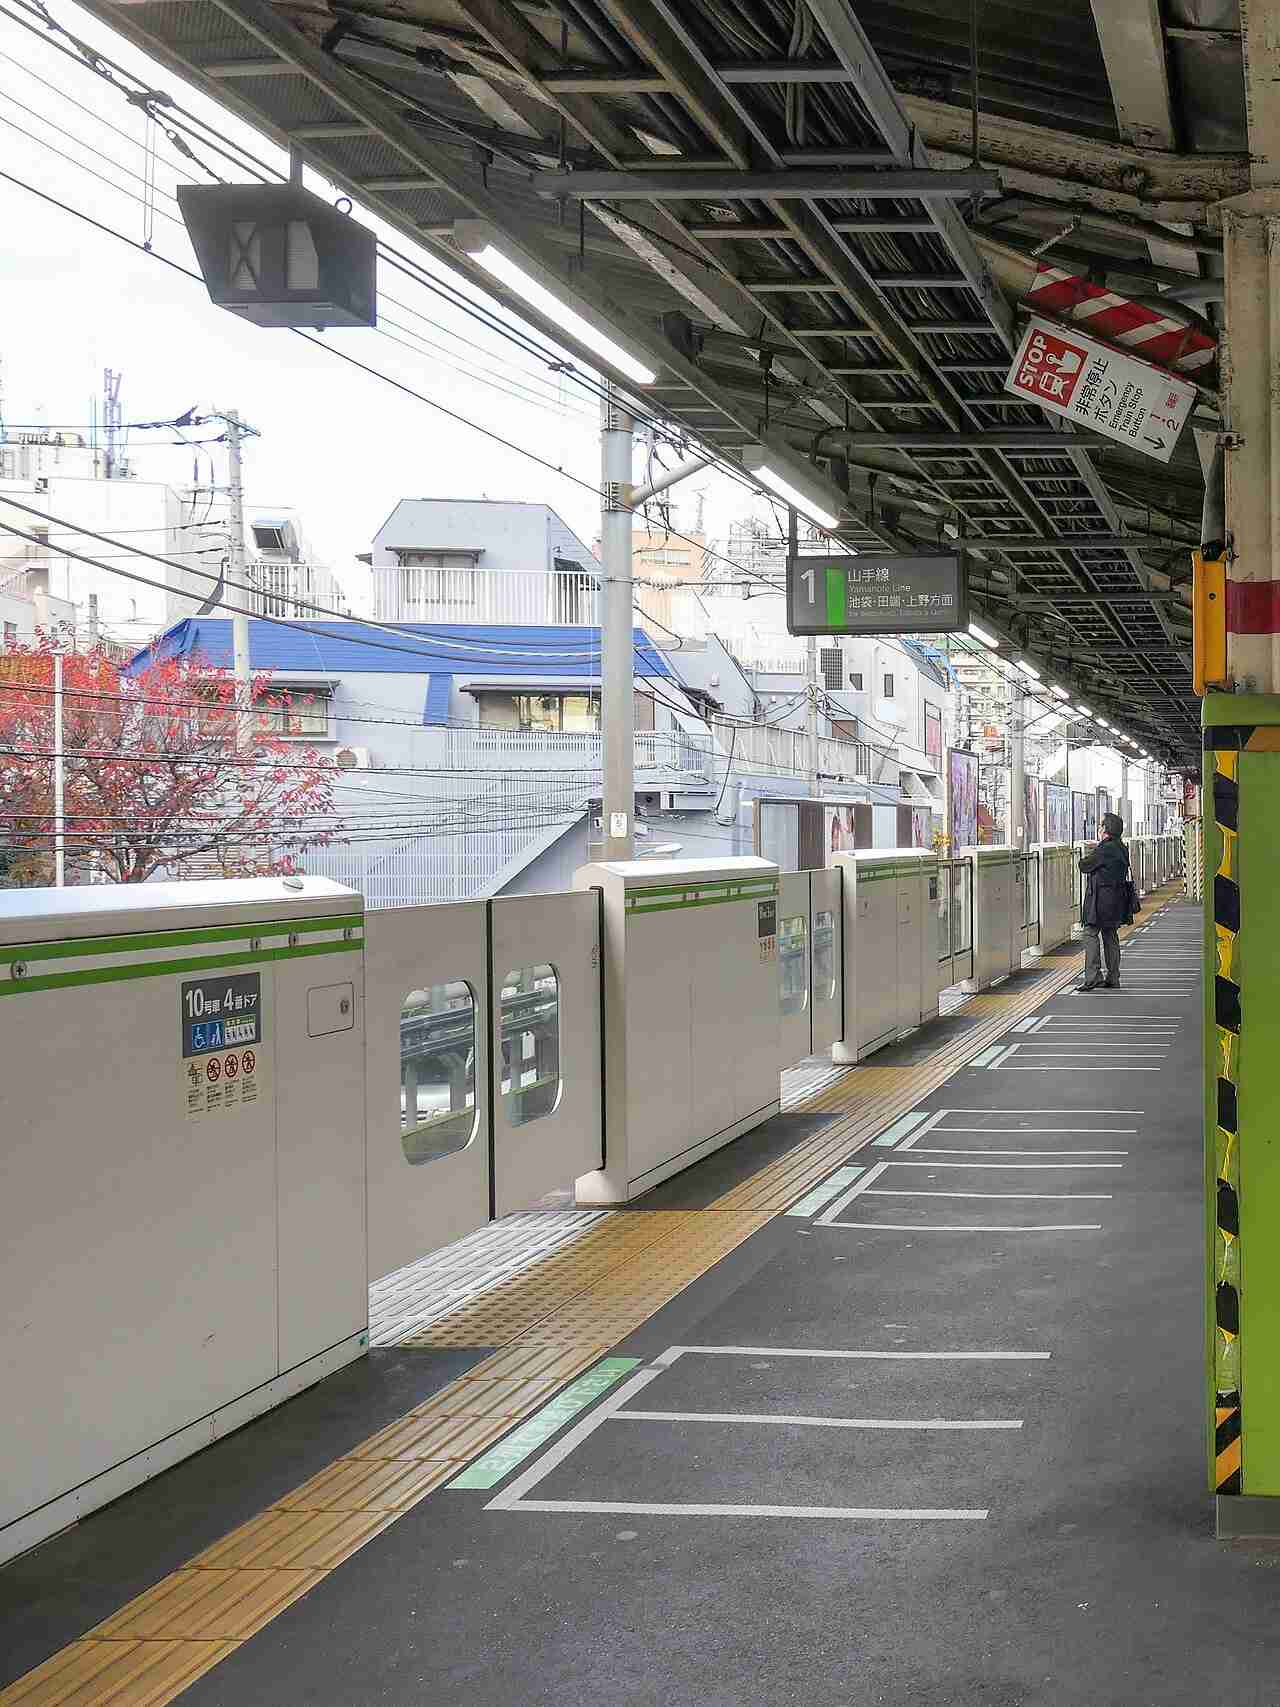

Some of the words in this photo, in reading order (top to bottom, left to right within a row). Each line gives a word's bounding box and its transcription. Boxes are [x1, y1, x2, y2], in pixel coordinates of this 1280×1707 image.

[1019, 335, 1048, 387] STOP
[1075, 358, 1110, 415] 非常停止
[1095, 380, 1117, 423] ボタン
[1109, 382, 1135, 430] Emergency
[1119, 409, 1134, 433] Train
[1130, 388, 1144, 410] Stop
[1128, 407, 1147, 438] Button
[800, 568, 816, 604] 1
[848, 568, 889, 583] 山手線
[185, 988, 221, 1019] 10号車
[223, 987, 258, 1014] 4番ドア
